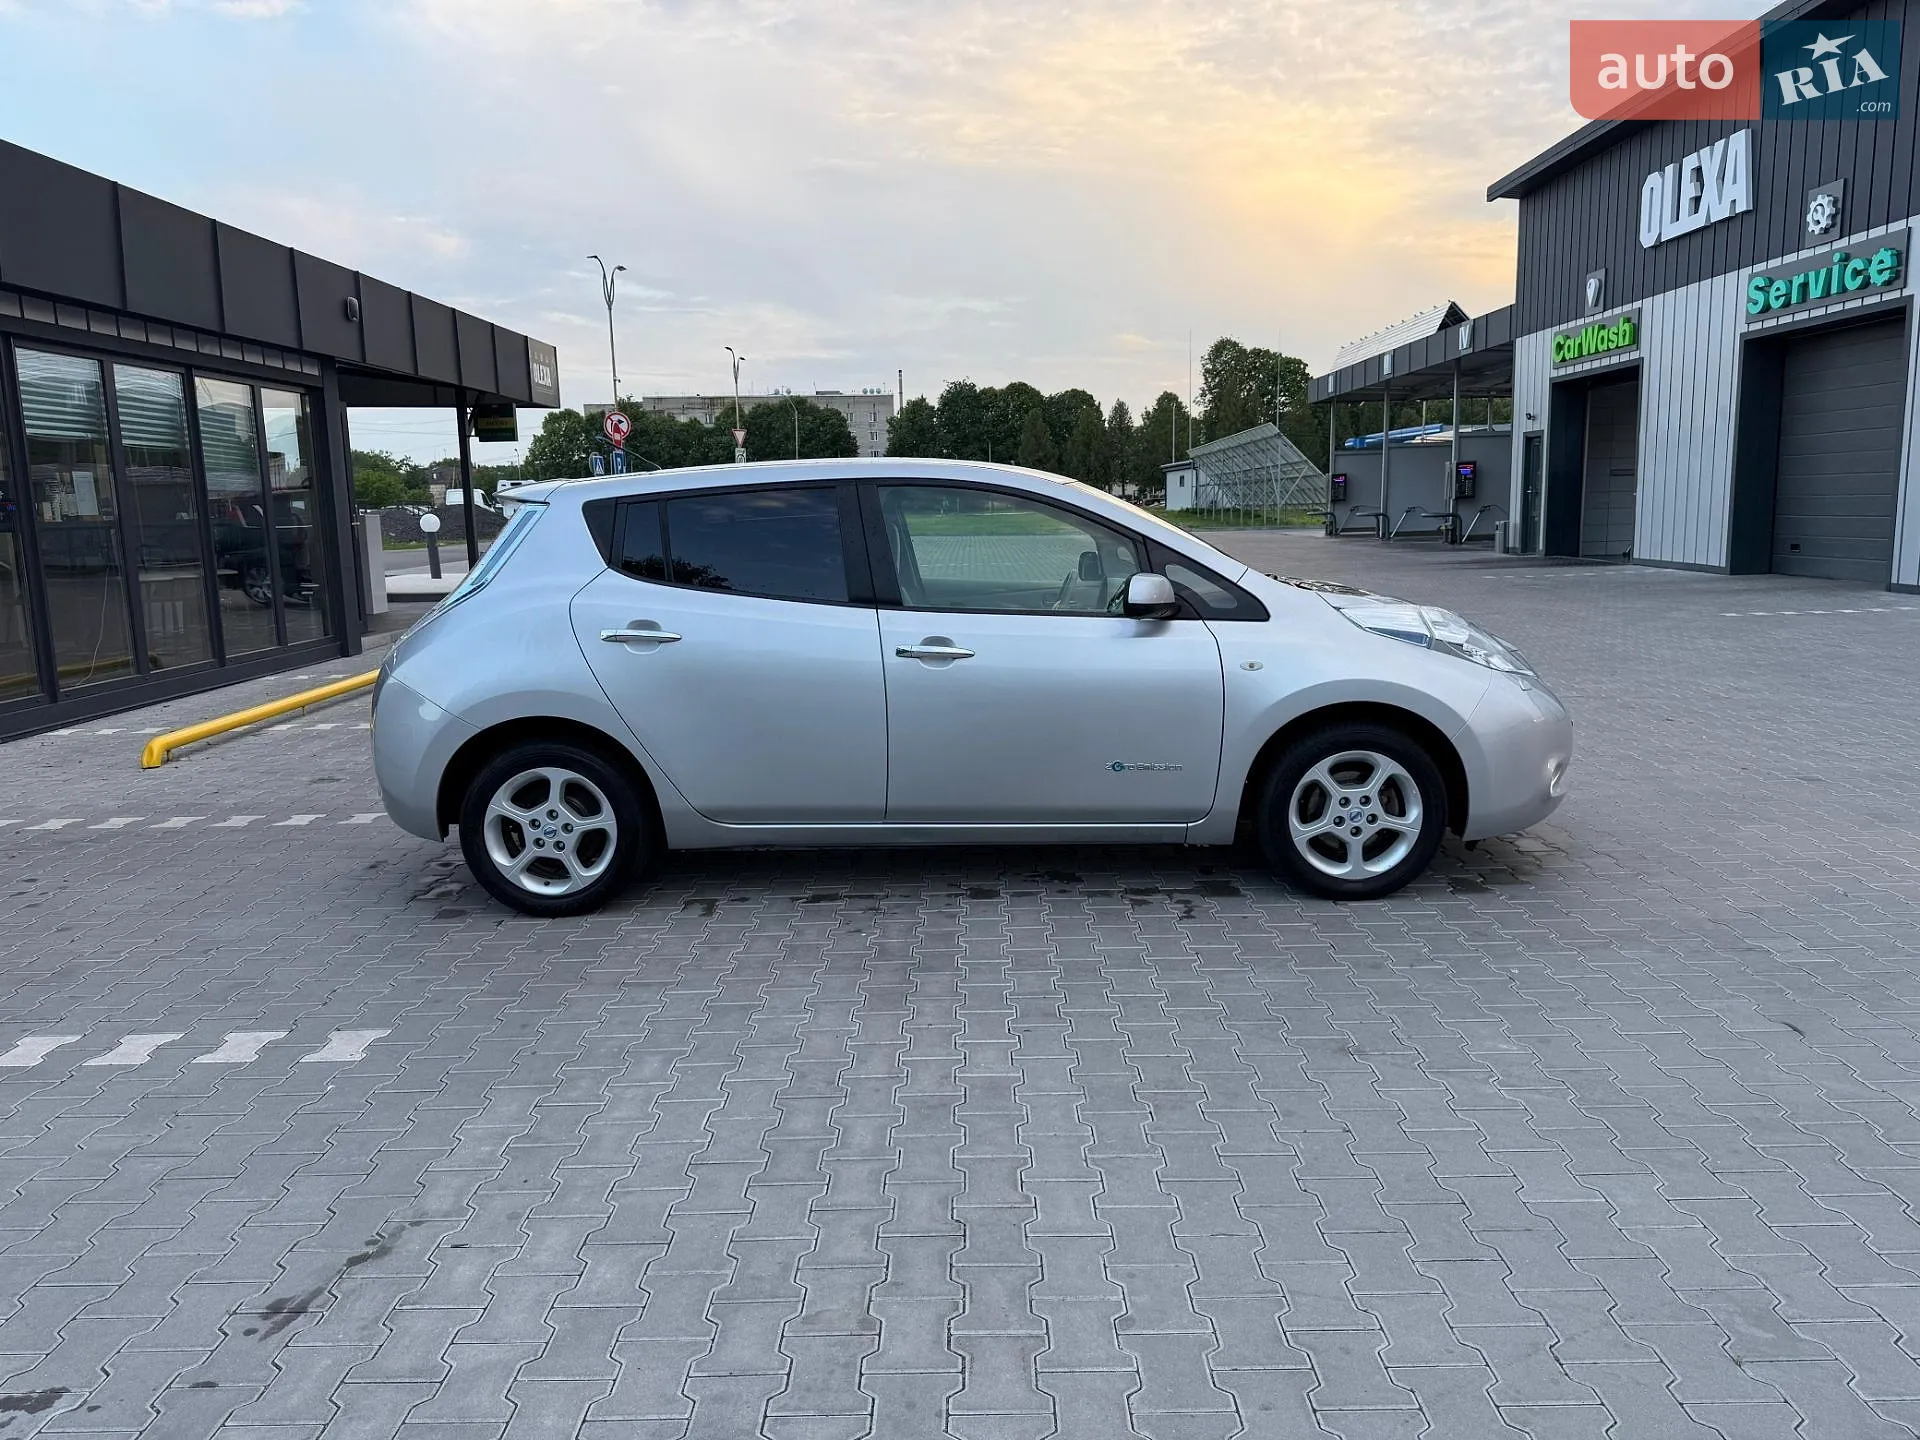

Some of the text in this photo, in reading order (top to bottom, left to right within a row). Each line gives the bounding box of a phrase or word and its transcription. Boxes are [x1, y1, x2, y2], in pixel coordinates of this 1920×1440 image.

[1639, 128, 1753, 249] OLEXA
[1746, 247, 1900, 315] Service
[1553, 316, 1634, 363] CarWash
